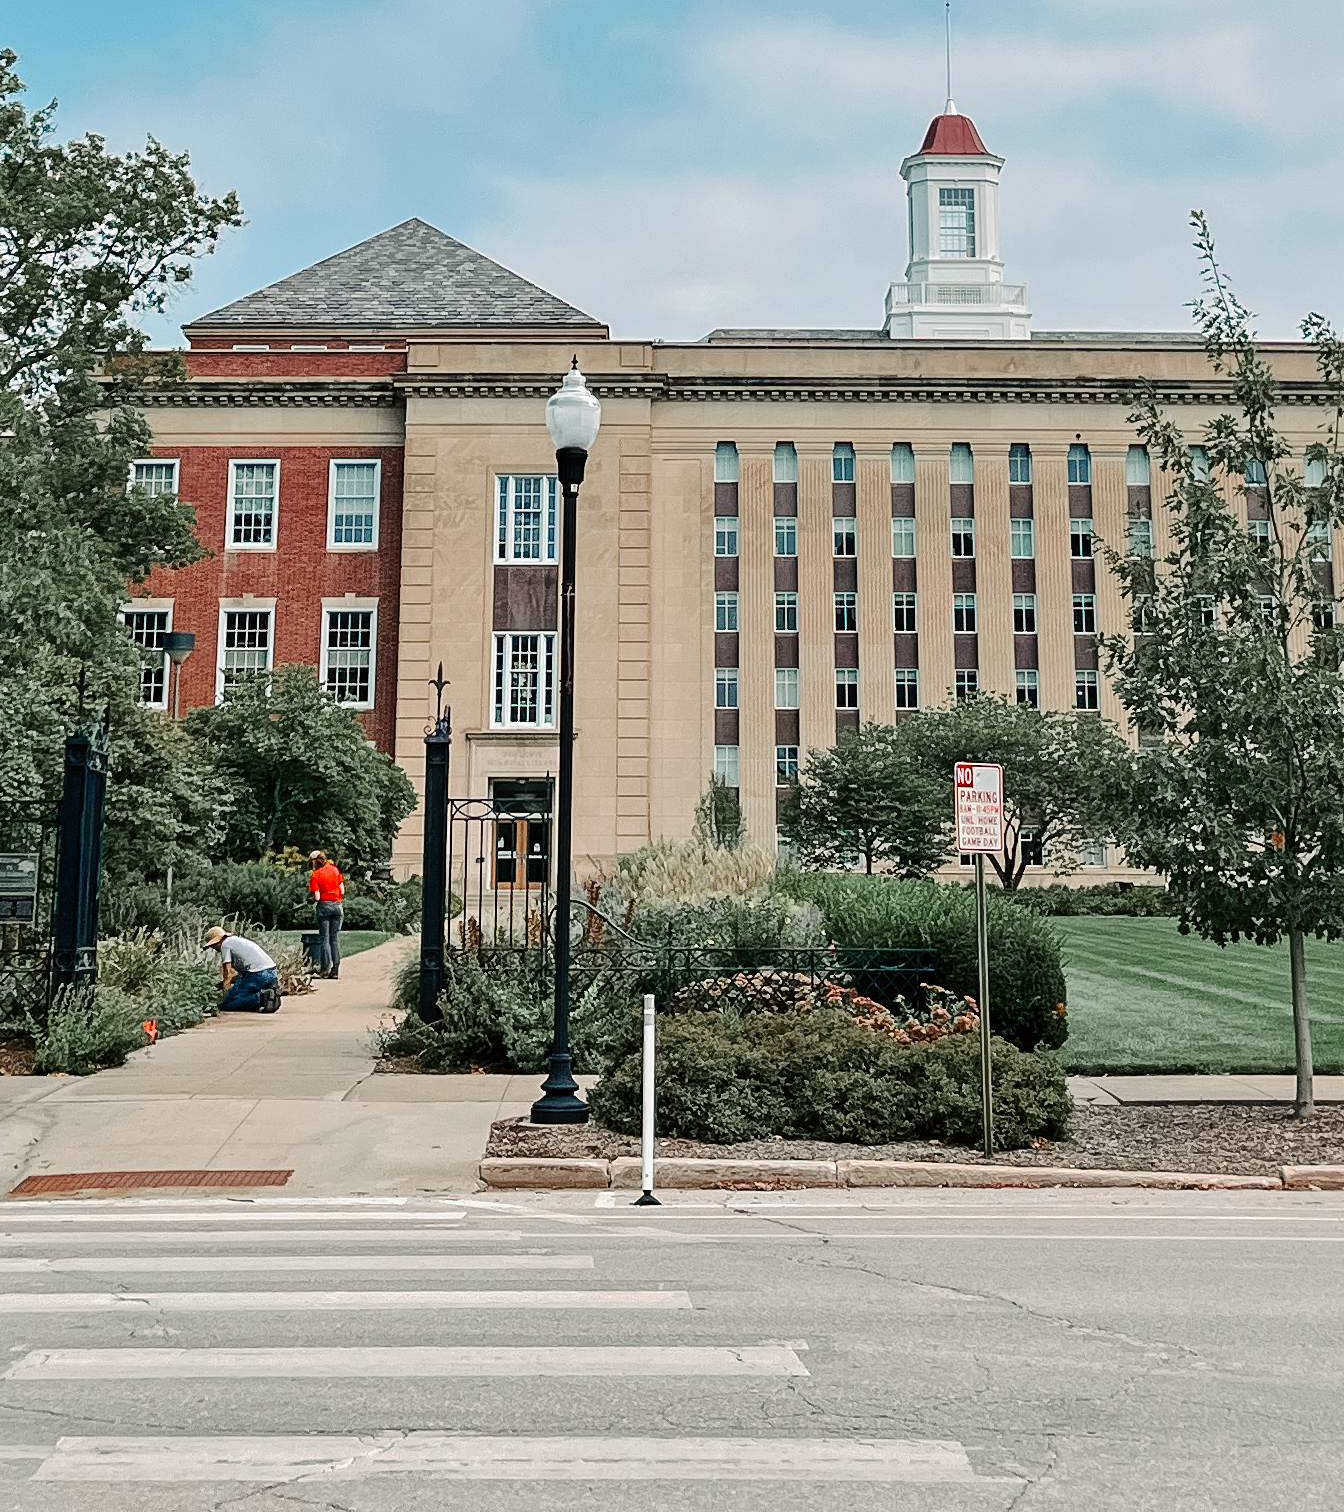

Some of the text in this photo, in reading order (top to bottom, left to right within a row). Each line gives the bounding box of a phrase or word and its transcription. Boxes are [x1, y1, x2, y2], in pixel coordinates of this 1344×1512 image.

[957, 767, 972, 785] NO
[960, 790, 998, 803] PARKING
[978, 816, 998, 825] HOME
[961, 826, 998, 836] FOOTBALL
[962, 837, 998, 847] GAME DAY
